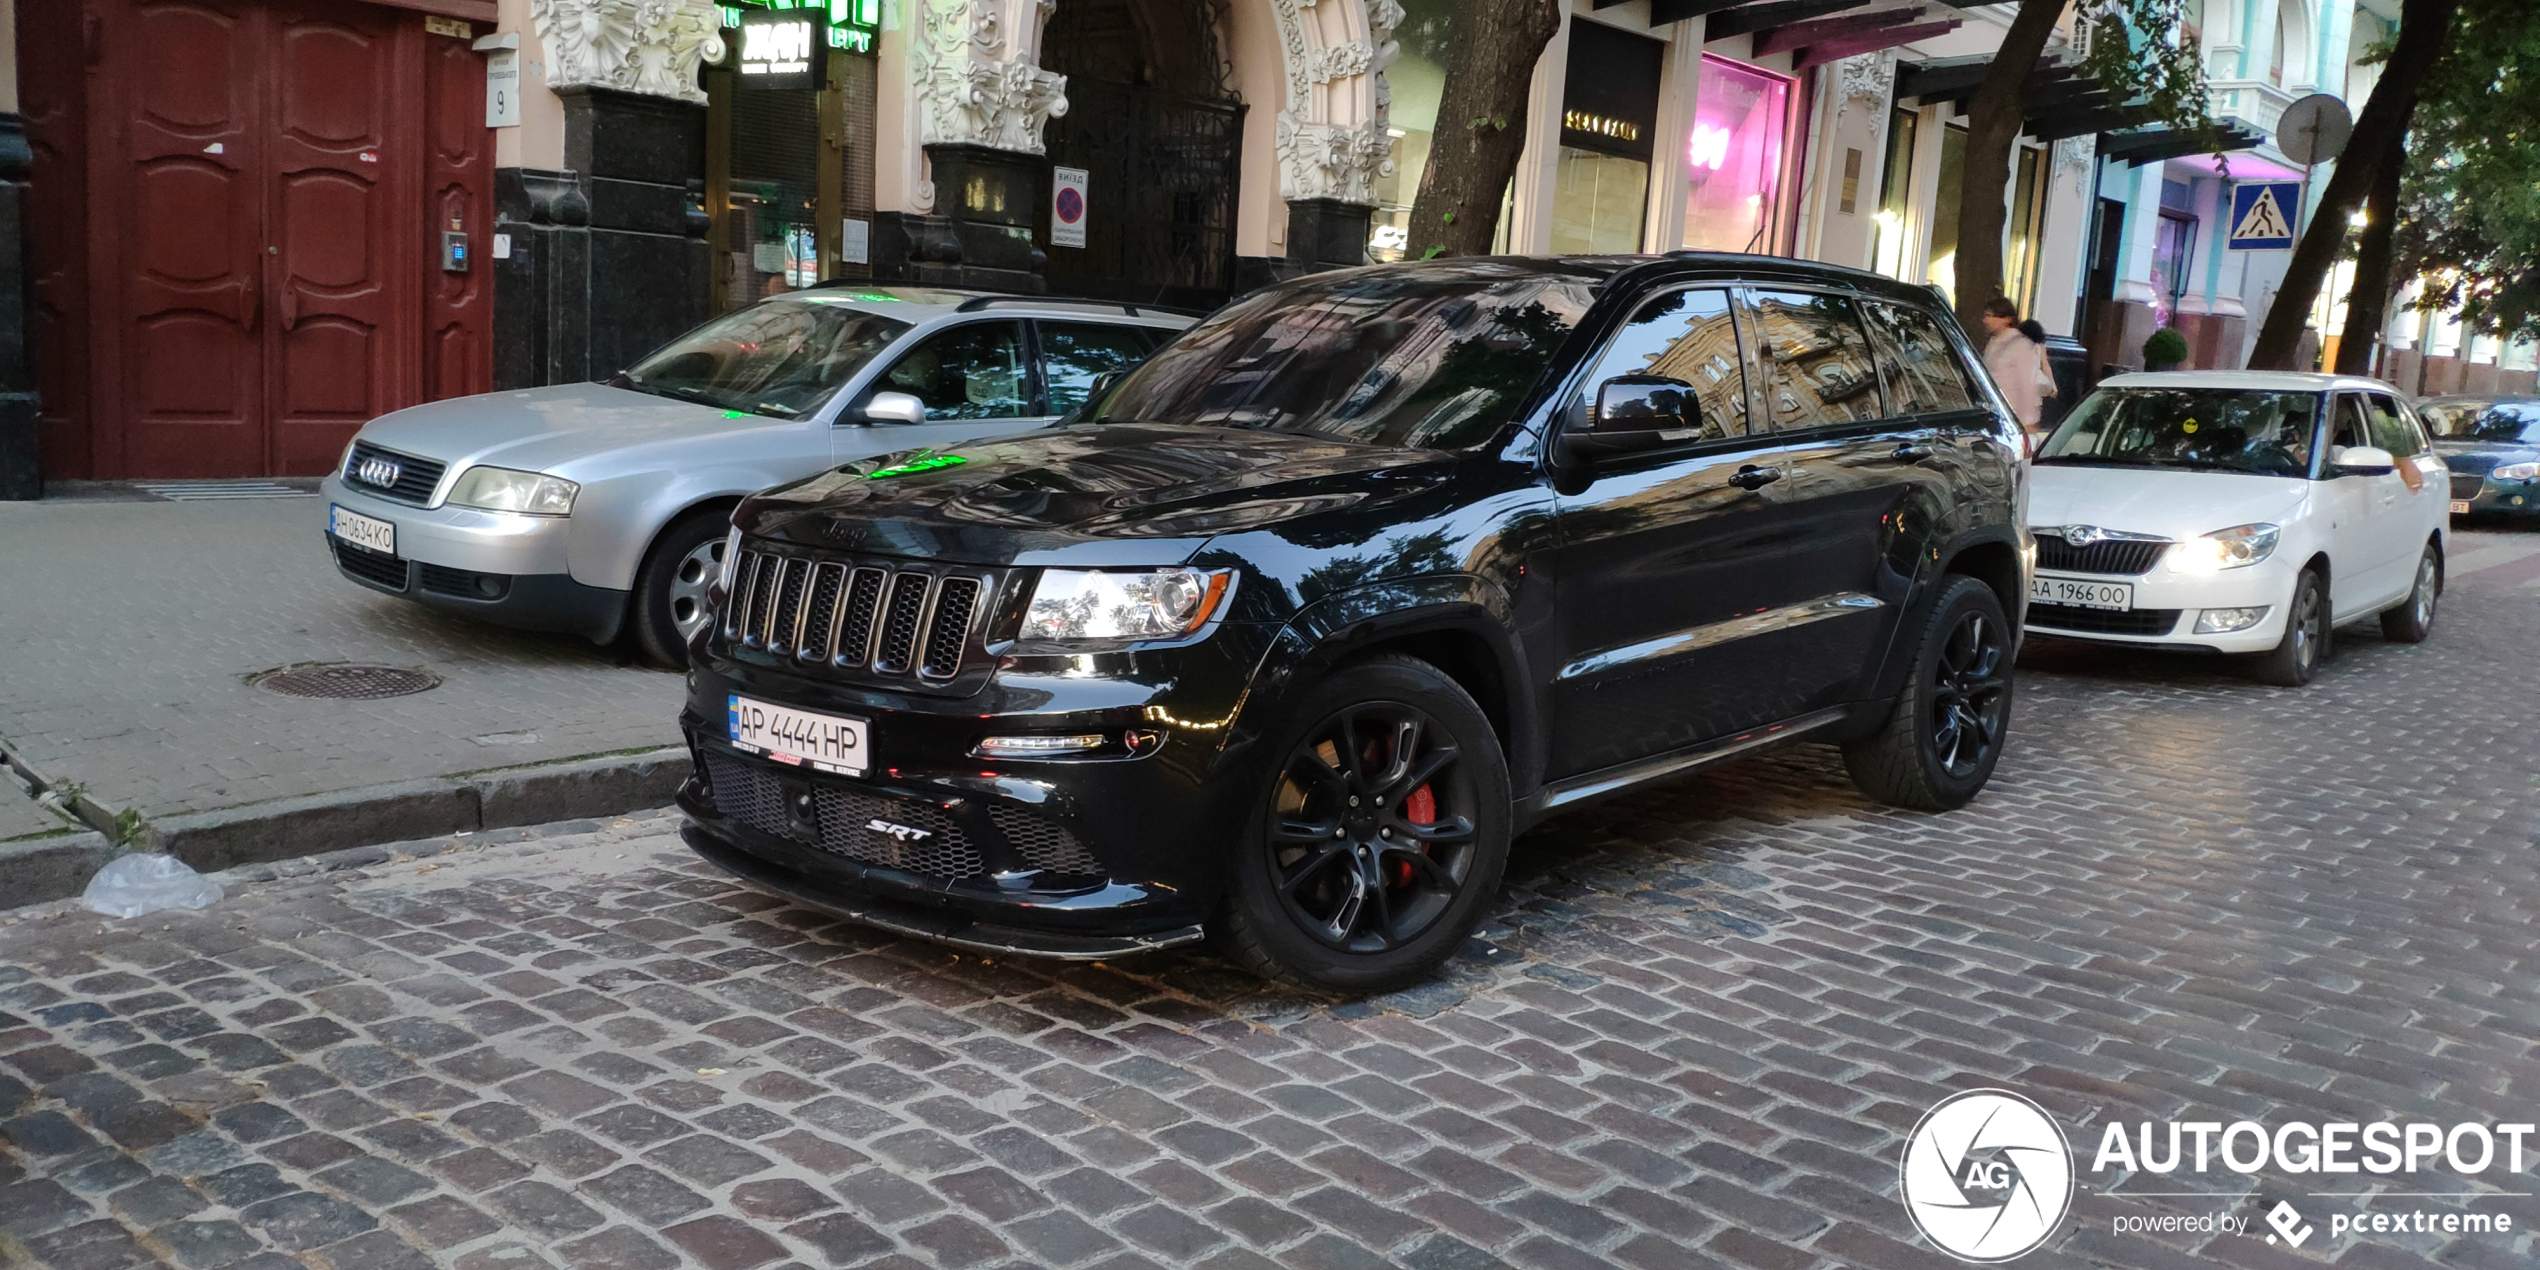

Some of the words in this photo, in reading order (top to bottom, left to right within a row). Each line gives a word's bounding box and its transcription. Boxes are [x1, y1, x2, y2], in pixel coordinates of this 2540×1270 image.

[497, 90, 505, 115] 9
[348, 517, 373, 544] 0634
[374, 524, 392, 549] KO
[2031, 580, 2051, 598] AA
[2057, 582, 2095, 602] 1966
[740, 705, 765, 740] AP
[770, 713, 819, 755] 4444
[823, 723, 858, 760] HP
[864, 819, 932, 841] SRT
